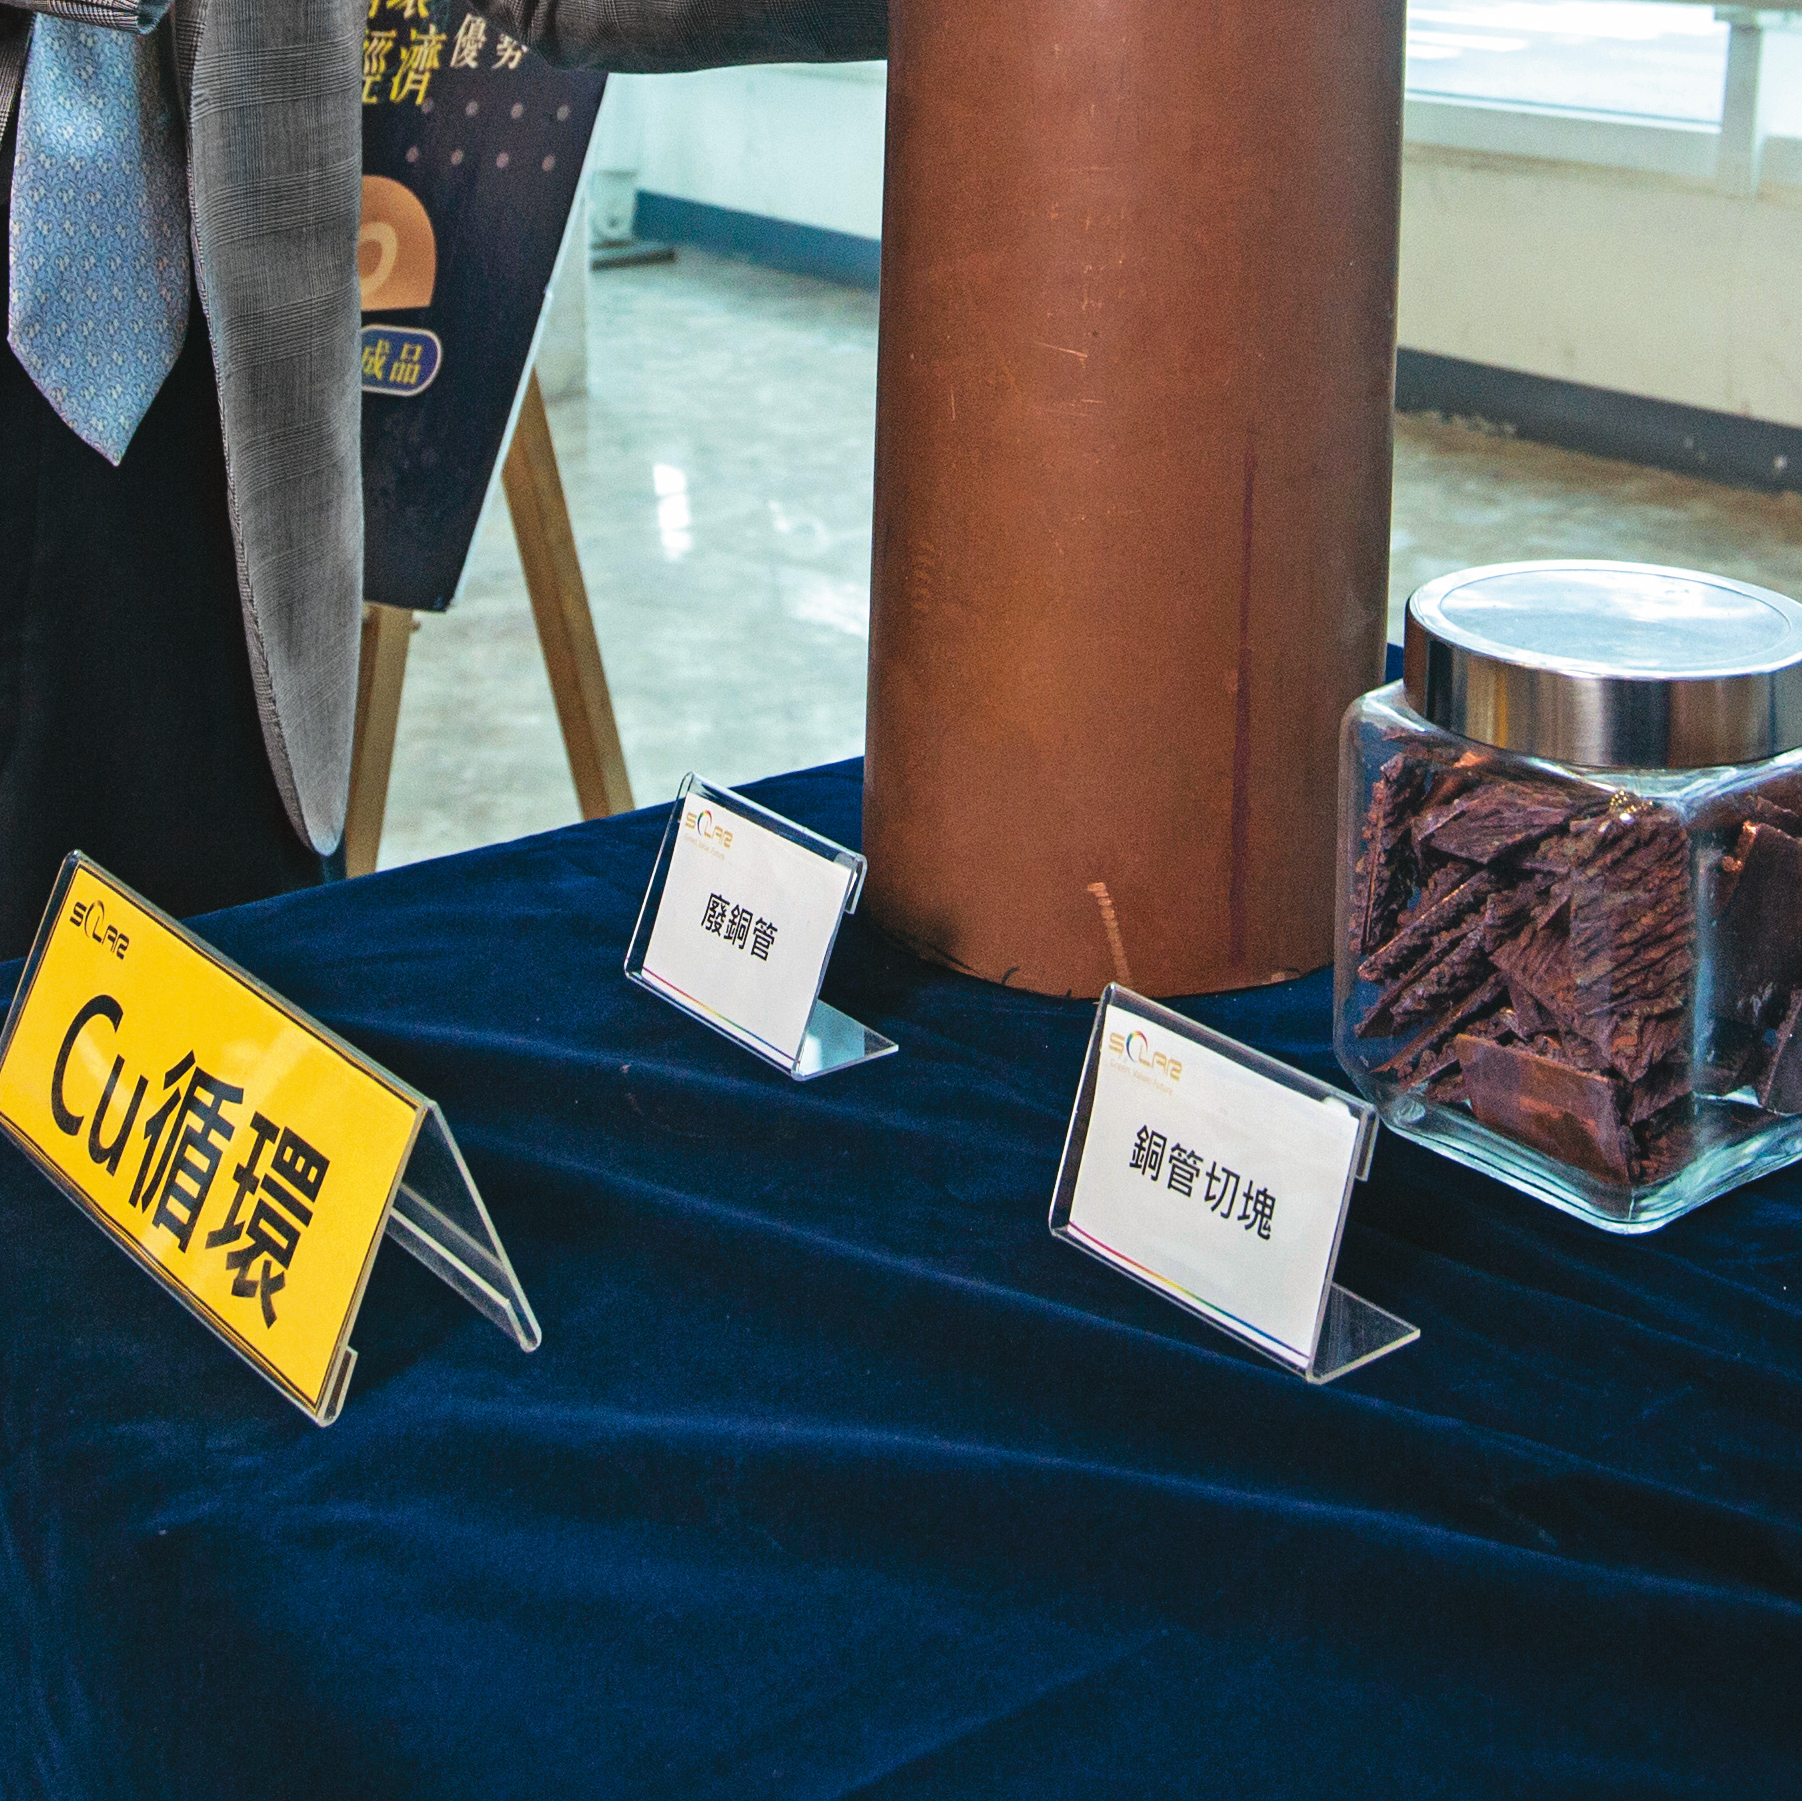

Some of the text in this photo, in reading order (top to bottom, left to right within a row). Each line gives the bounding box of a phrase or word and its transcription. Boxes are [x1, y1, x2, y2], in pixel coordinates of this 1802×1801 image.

[700, 892, 778, 961] 廢銅管
[50, 994, 331, 1329] Cu循環
[1129, 1124, 1277, 1241] 銅管切塊
